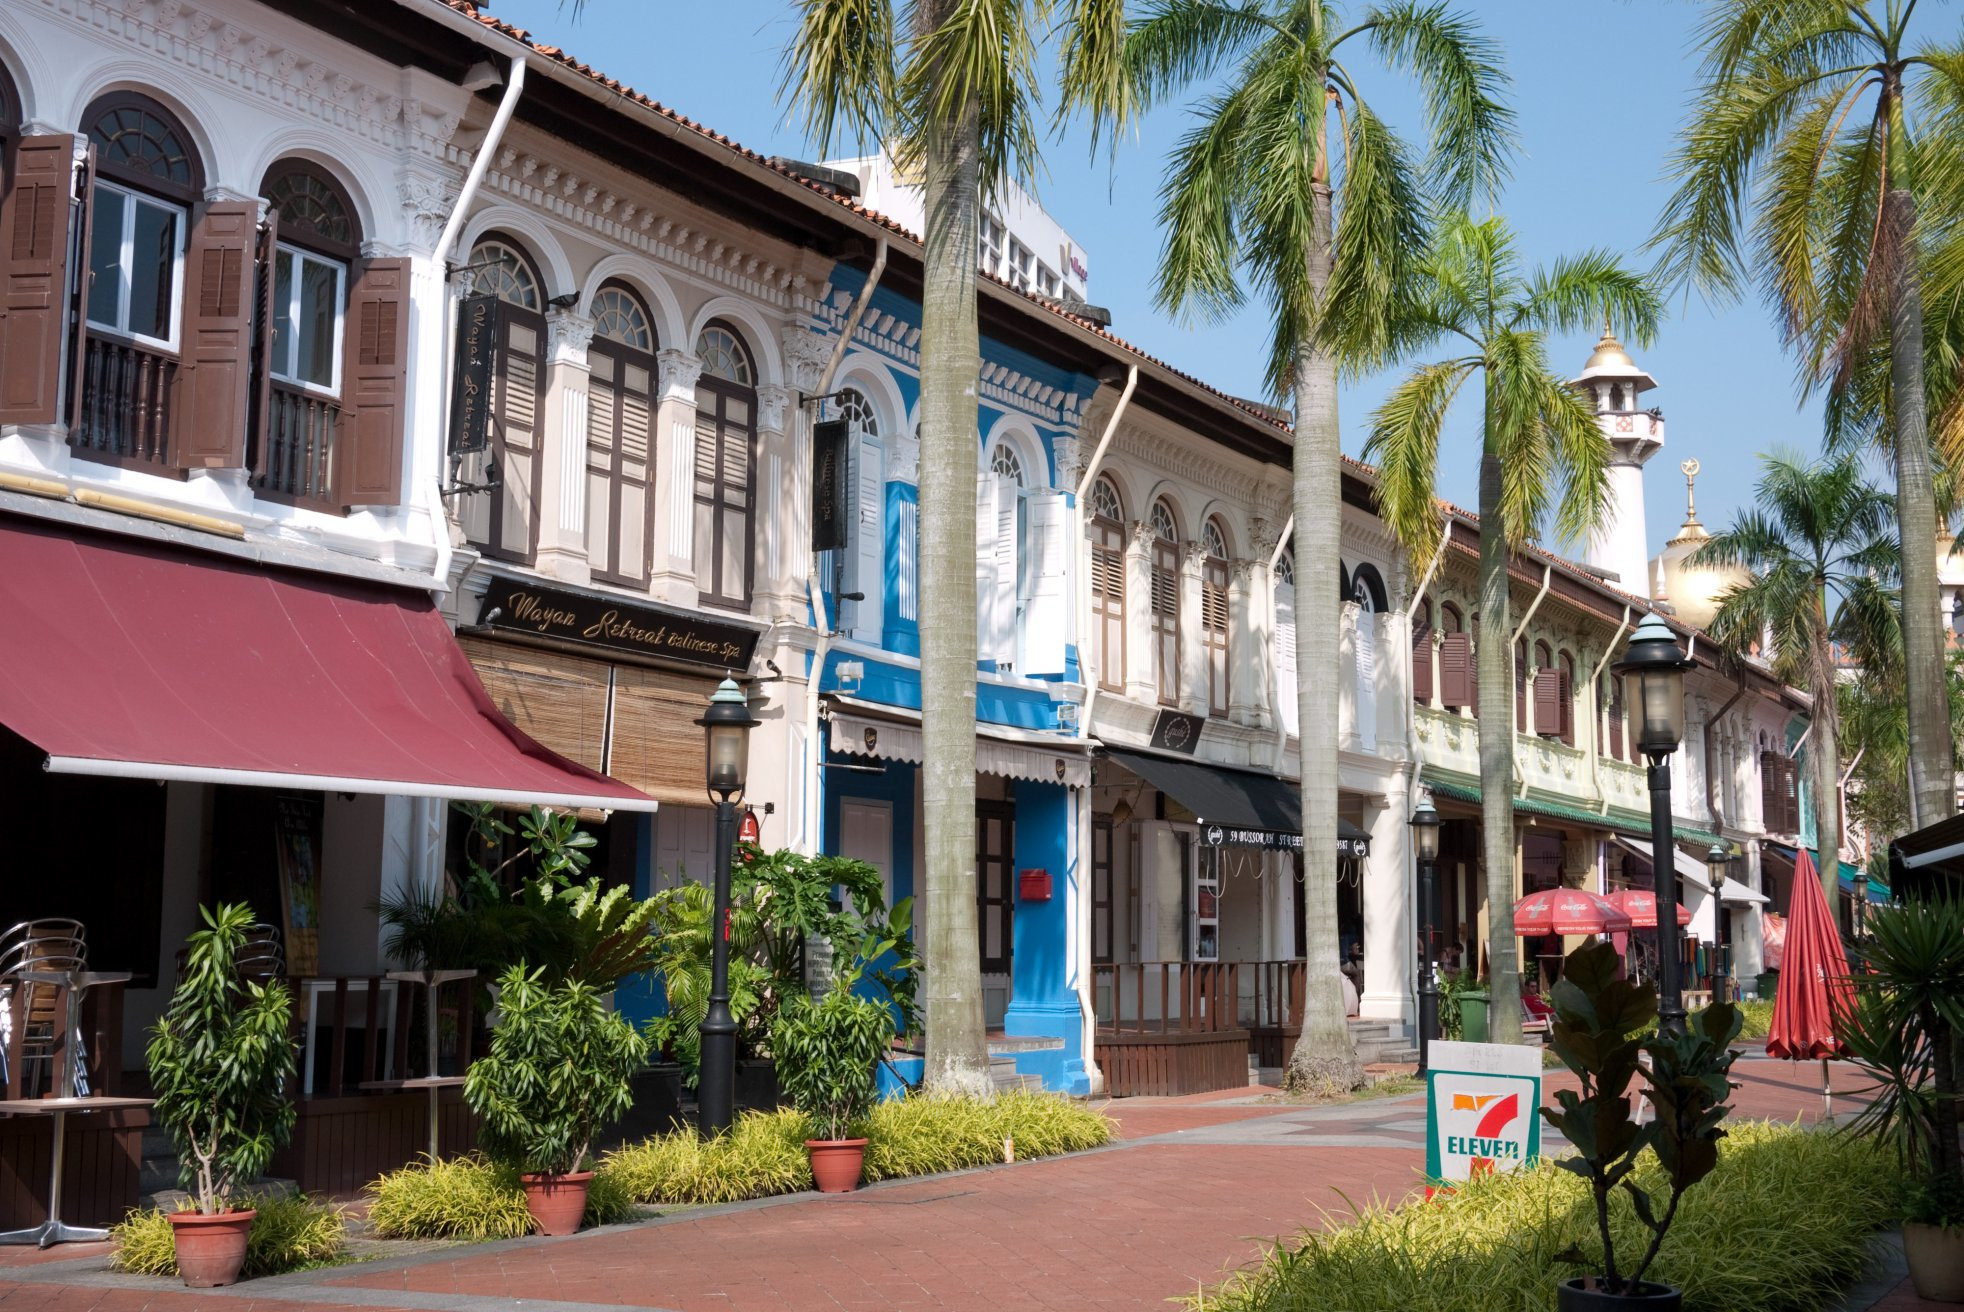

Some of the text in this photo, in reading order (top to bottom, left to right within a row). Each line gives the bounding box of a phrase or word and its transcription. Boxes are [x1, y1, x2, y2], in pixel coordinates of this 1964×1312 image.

[462, 304, 486, 448] Wayan Retreat
[508, 592, 741, 662] Wayan Retreat Balinese Spa
[1448, 1136, 1518, 1159] ELEVEn
